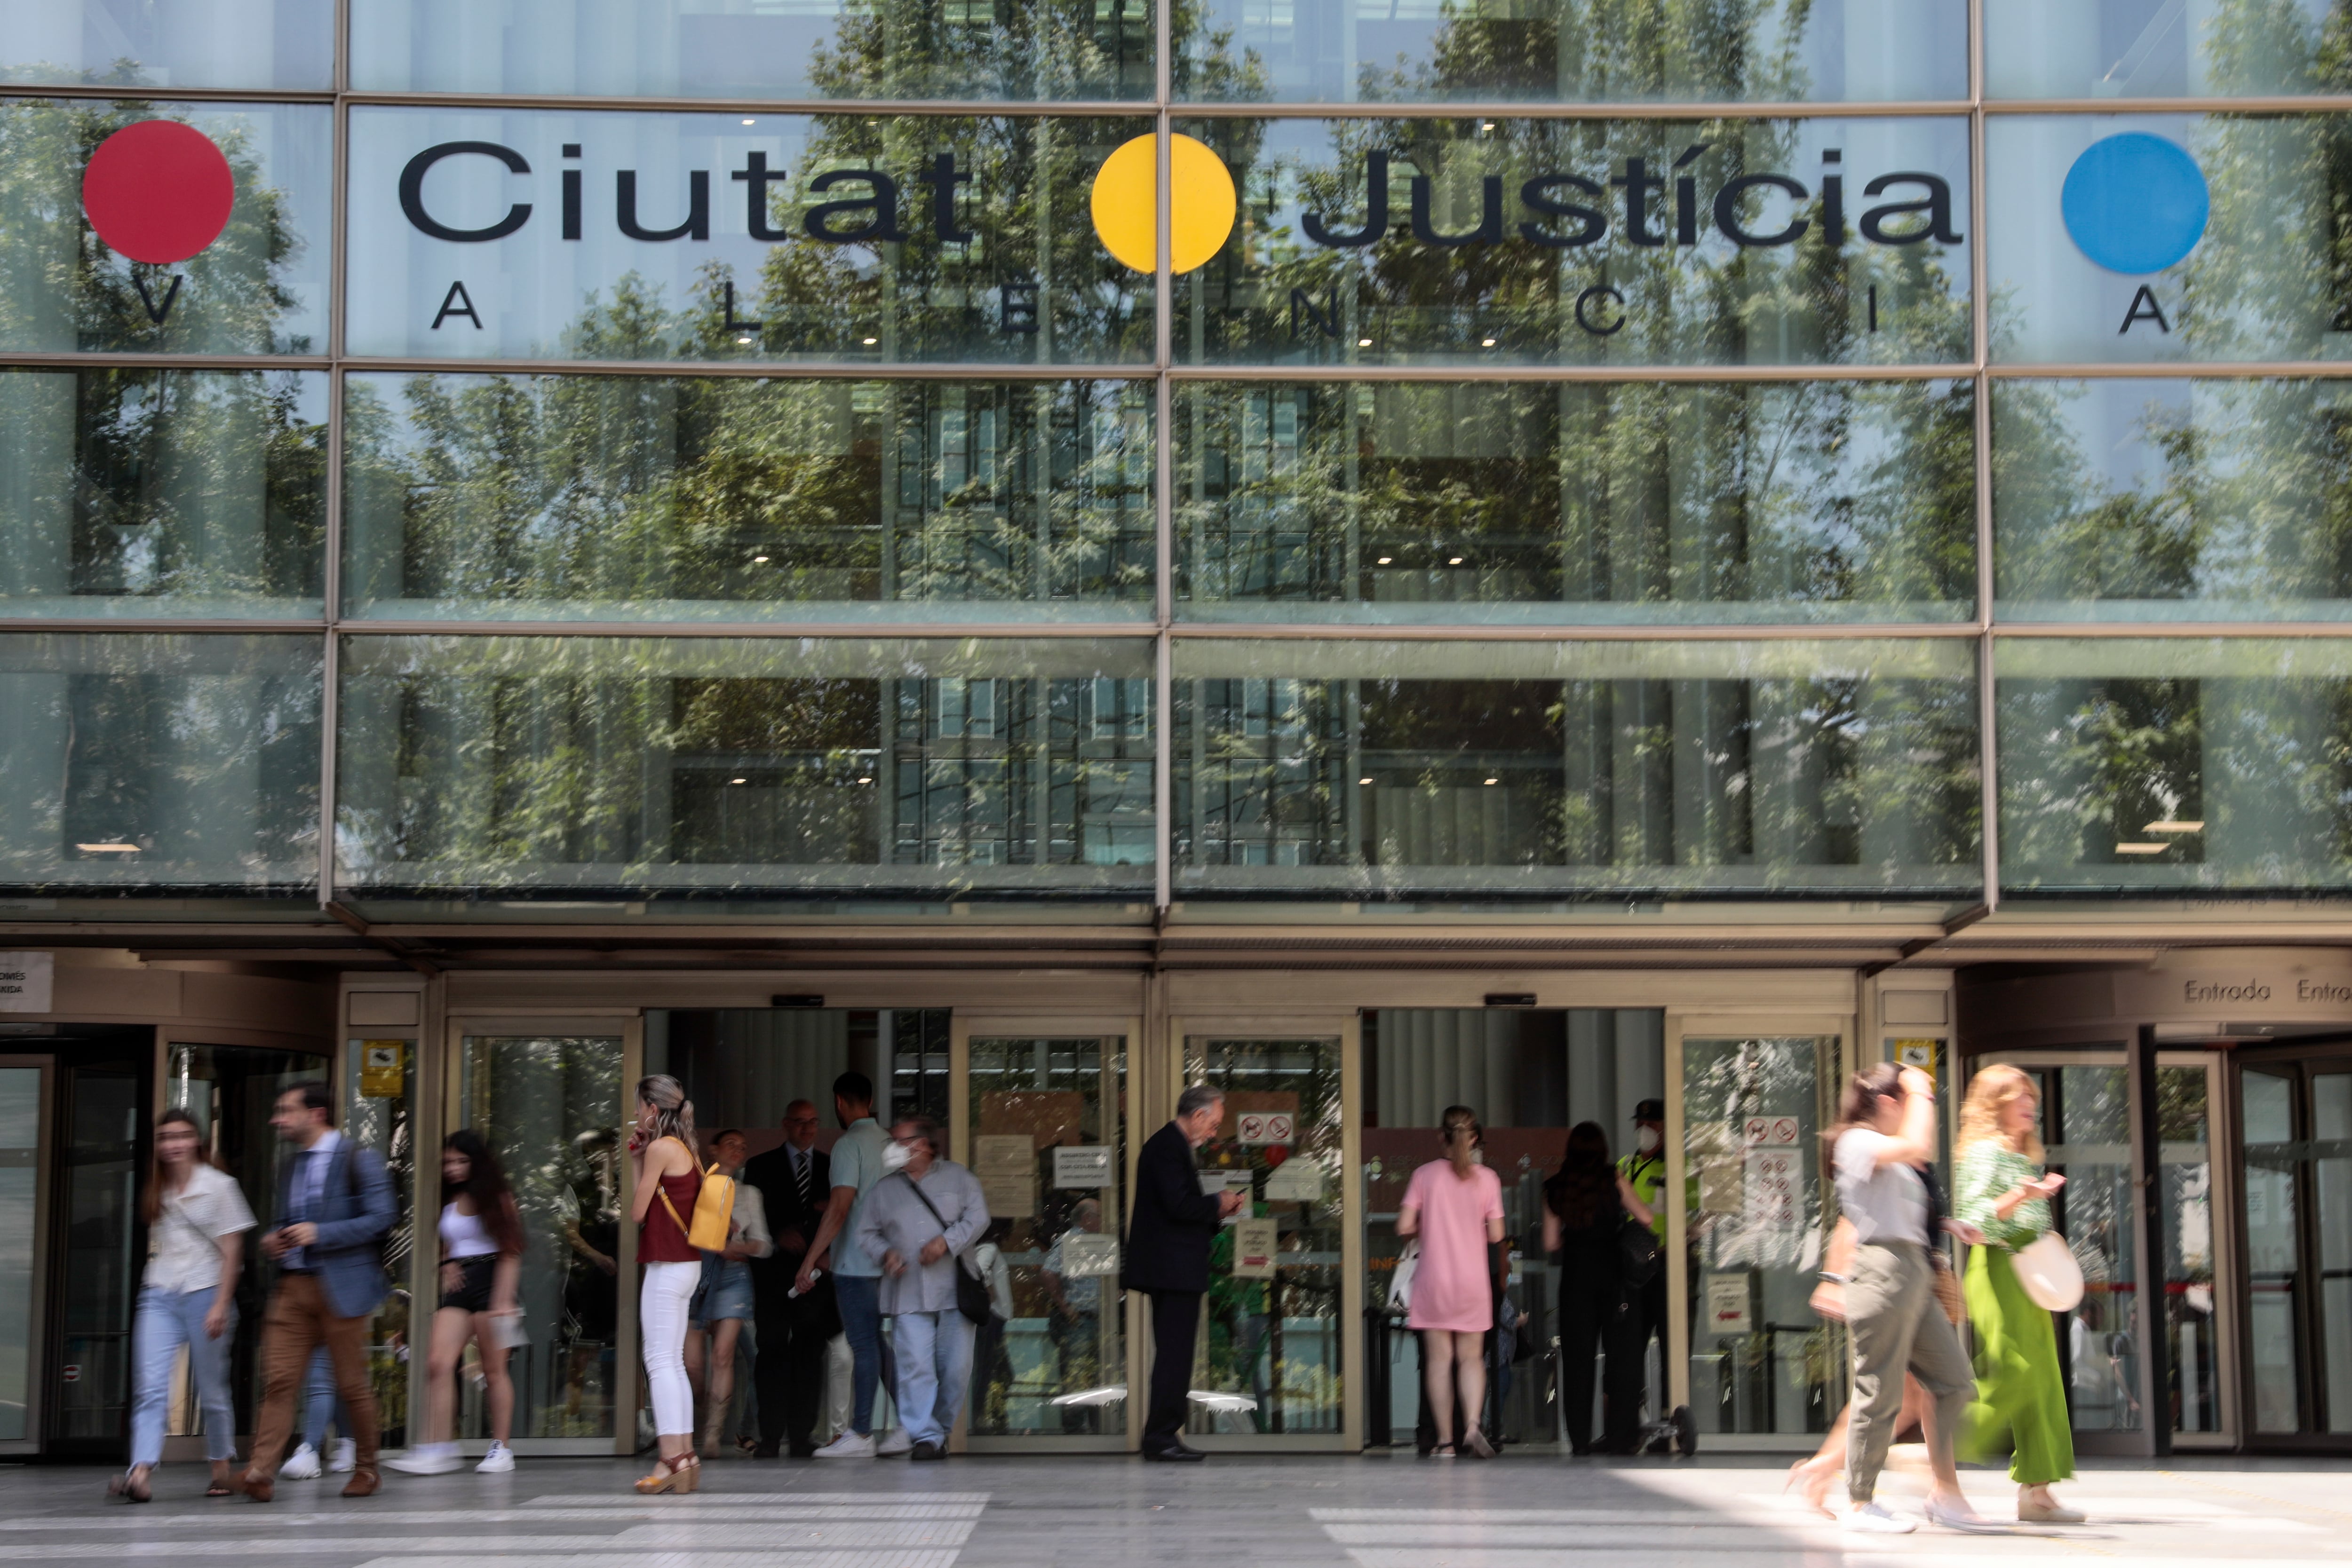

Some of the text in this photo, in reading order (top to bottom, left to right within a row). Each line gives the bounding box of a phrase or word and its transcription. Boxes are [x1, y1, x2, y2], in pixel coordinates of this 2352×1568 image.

[399, 140, 1963, 247] Ciutat Justícia
[2185, 978, 2271, 1003] Entrada
